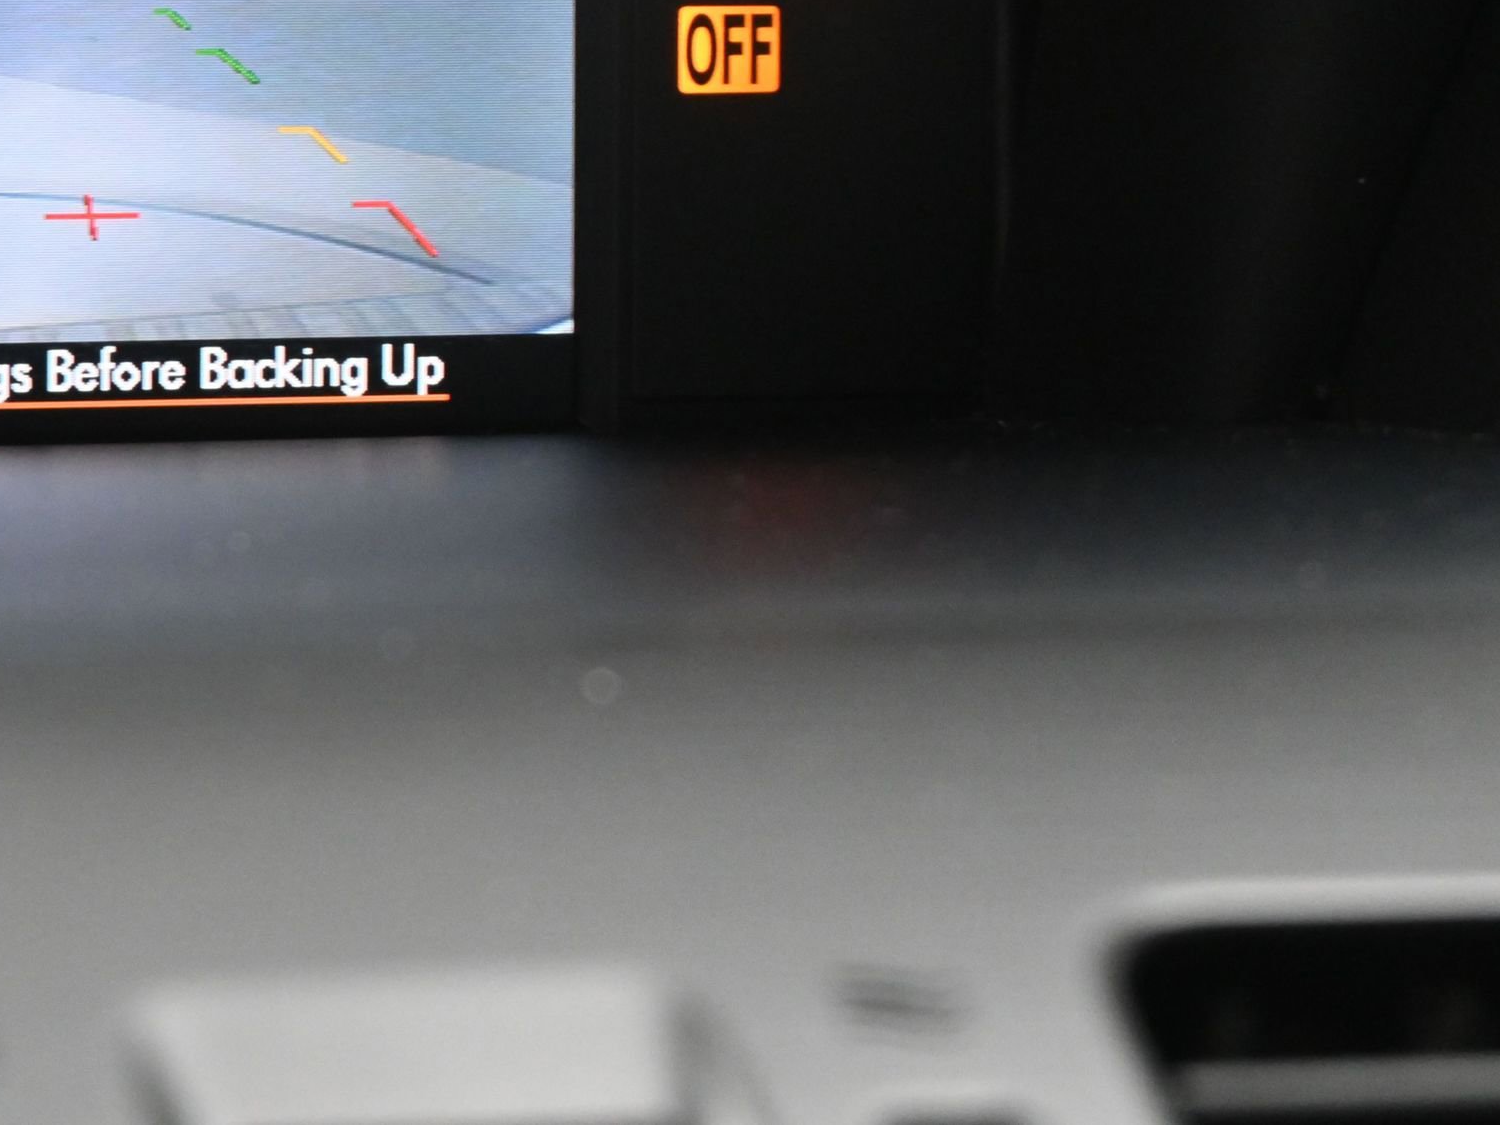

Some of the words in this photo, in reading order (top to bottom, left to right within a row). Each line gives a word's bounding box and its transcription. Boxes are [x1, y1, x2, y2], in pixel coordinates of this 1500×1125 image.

[686, 12, 774, 87] OFF
[47, 345, 187, 393] Before
[200, 344, 370, 399] Backing
[382, 342, 446, 395] Up
